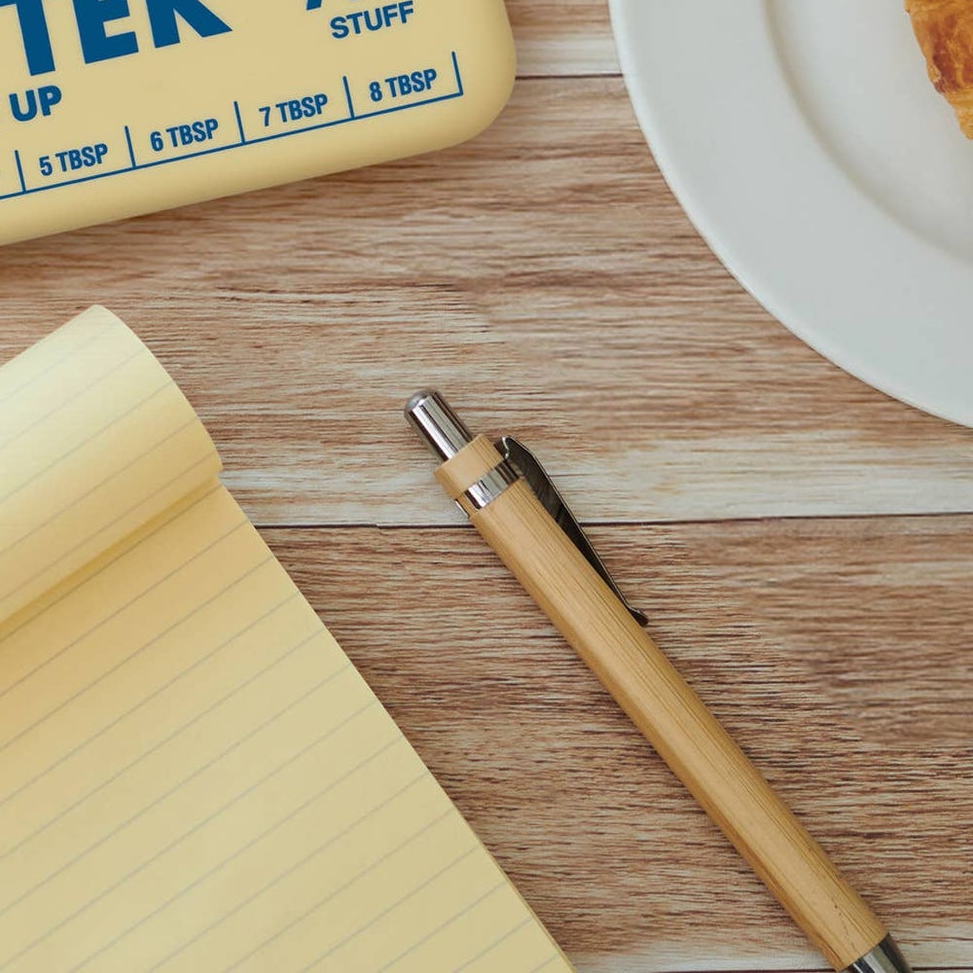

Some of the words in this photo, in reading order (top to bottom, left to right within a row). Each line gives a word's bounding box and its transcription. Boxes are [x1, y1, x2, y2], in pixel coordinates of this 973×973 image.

[330, 0, 415, 39] STUFF
[369, 81, 383, 102] 8
[385, 69, 438, 98] TBSP
[9, 85, 62, 122] UP
[259, 106, 272, 127] 7
[275, 93, 329, 123] TBSP
[150, 131, 164, 152] 6
[166, 118, 220, 147] TBSP
[39, 155, 53, 177] 5
[55, 143, 109, 172] TBSP
